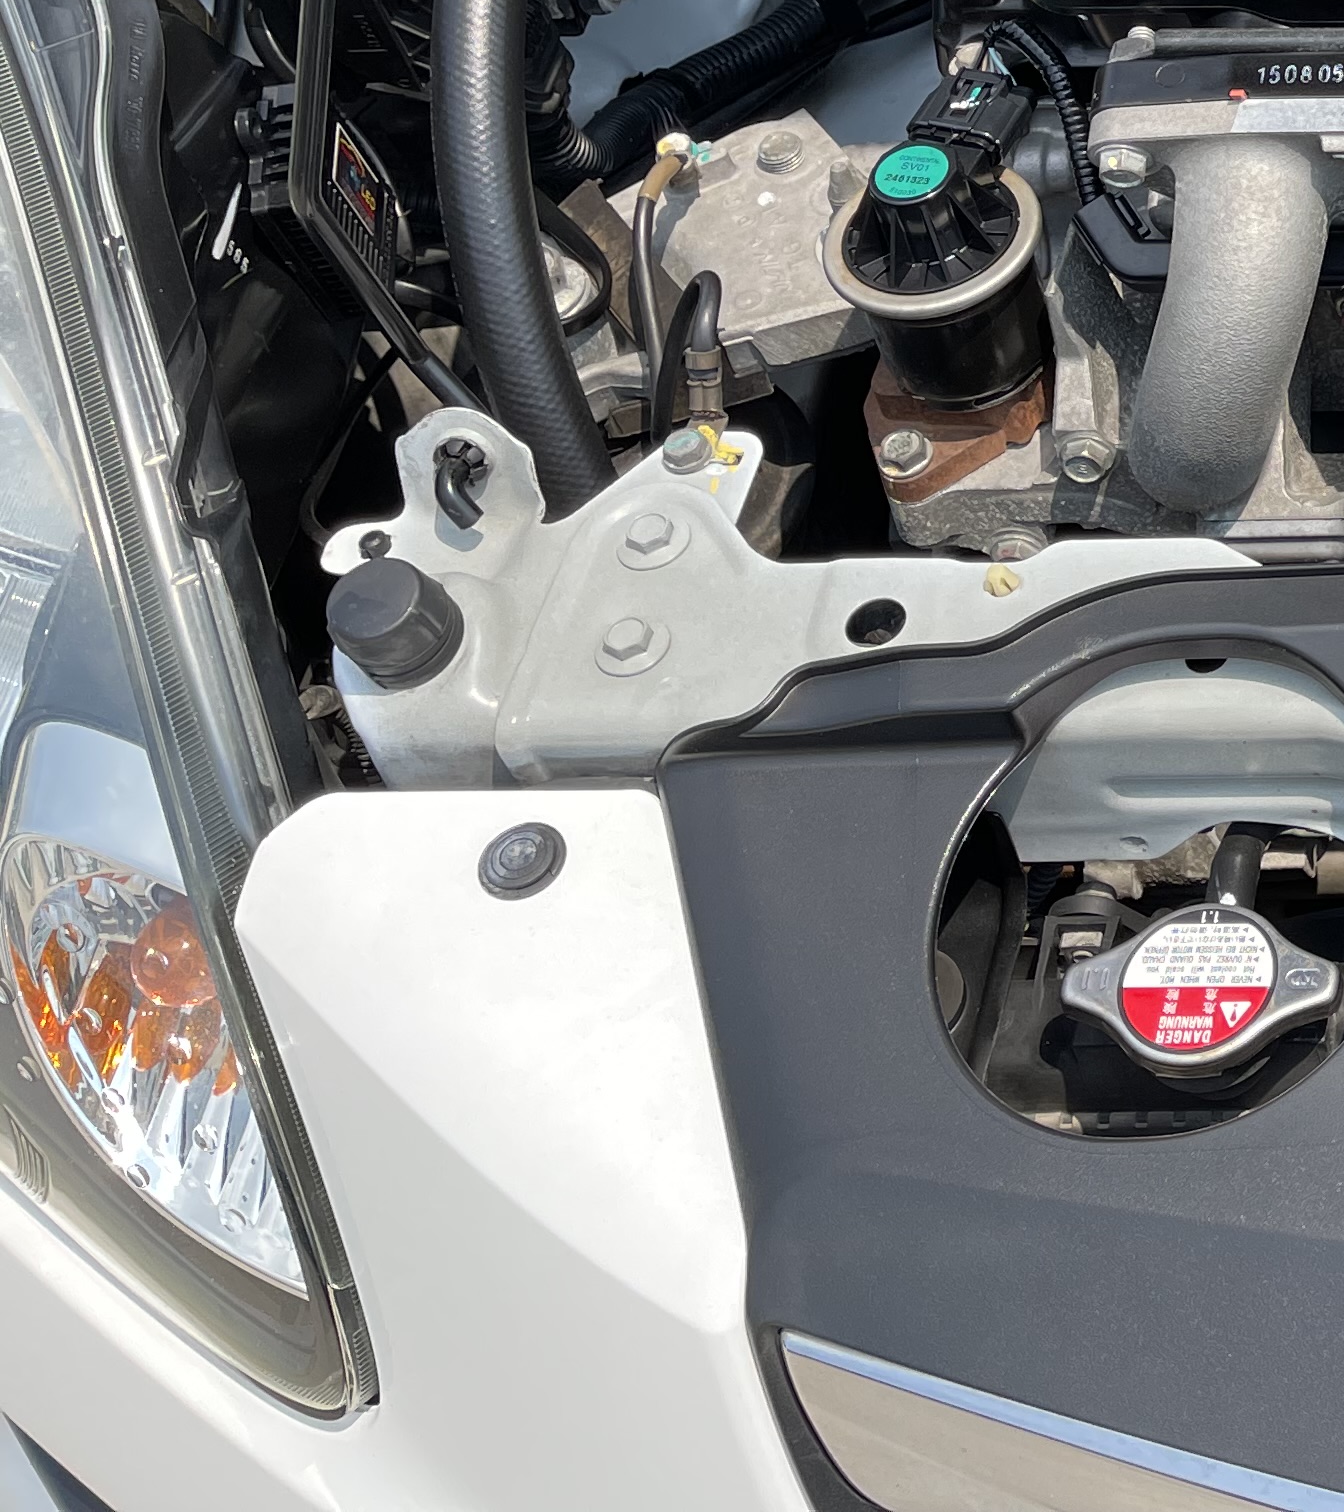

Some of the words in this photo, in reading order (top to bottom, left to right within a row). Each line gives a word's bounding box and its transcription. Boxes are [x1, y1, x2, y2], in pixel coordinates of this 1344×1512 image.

[1198, 955, 1211, 963] PAS
[1180, 975, 1200, 984] WHEN
[1206, 975, 1225, 984] OPEN
[1231, 975, 1253, 984] NEVER
[1158, 1015, 1214, 1029] WARNUNG
[1154, 1030, 1212, 1044] DANGER
